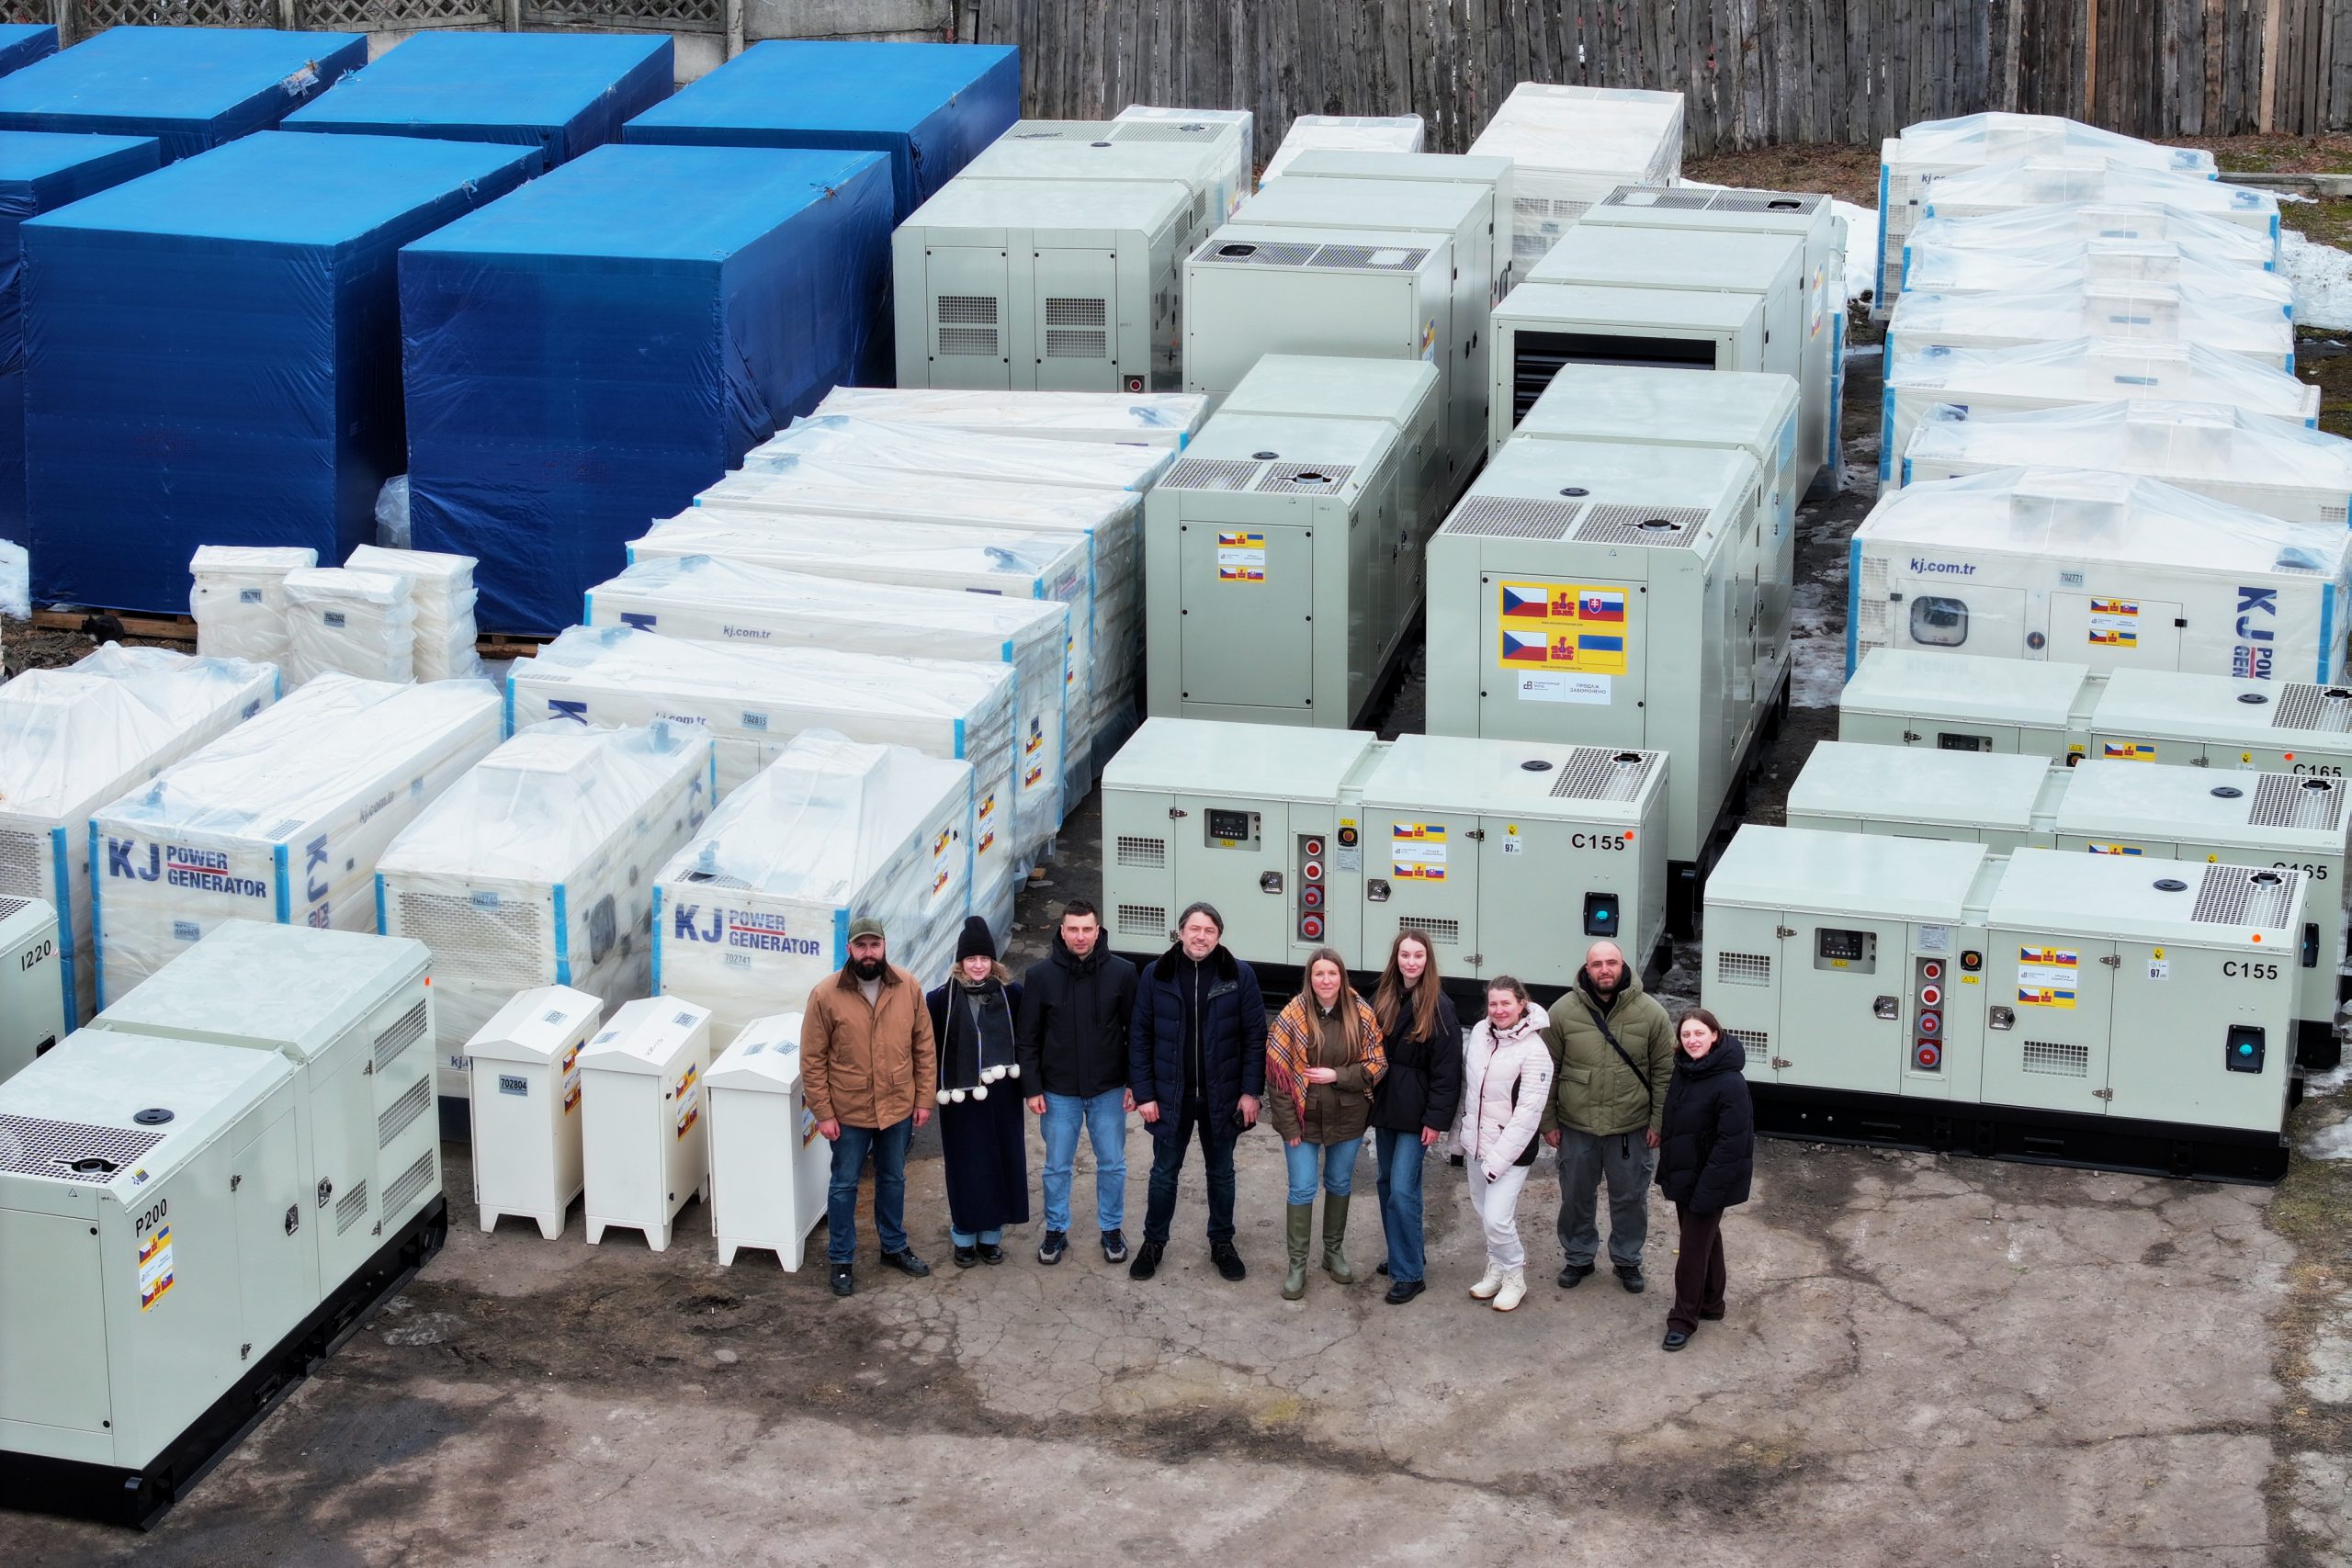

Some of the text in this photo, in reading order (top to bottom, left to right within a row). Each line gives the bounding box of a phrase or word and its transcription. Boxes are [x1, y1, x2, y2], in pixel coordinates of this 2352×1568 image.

[1910, 558, 1976, 575] kj.com.tr
[2235, 586, 2278, 641] KJ
[723, 625, 772, 638] kj.com.tr
[742, 713, 767, 726] 702815
[1505, 843, 1514, 852] 97
[1571, 833, 1624, 851] C155
[107, 837, 161, 882] KJ
[166, 845, 229, 870] POWER
[306, 833, 329, 903] KJ
[167, 869, 267, 898] GENERATOR
[674, 903, 723, 943] KJ
[729, 909, 786, 931] POWER
[729, 931, 820, 956] GENERATOR
[725, 953, 751, 964] 702741
[2150, 968, 2160, 978] 97
[2222, 961, 2278, 980] C155
[501, 1078, 527, 1090] 702804
[135, 1198, 167, 1238] P200
